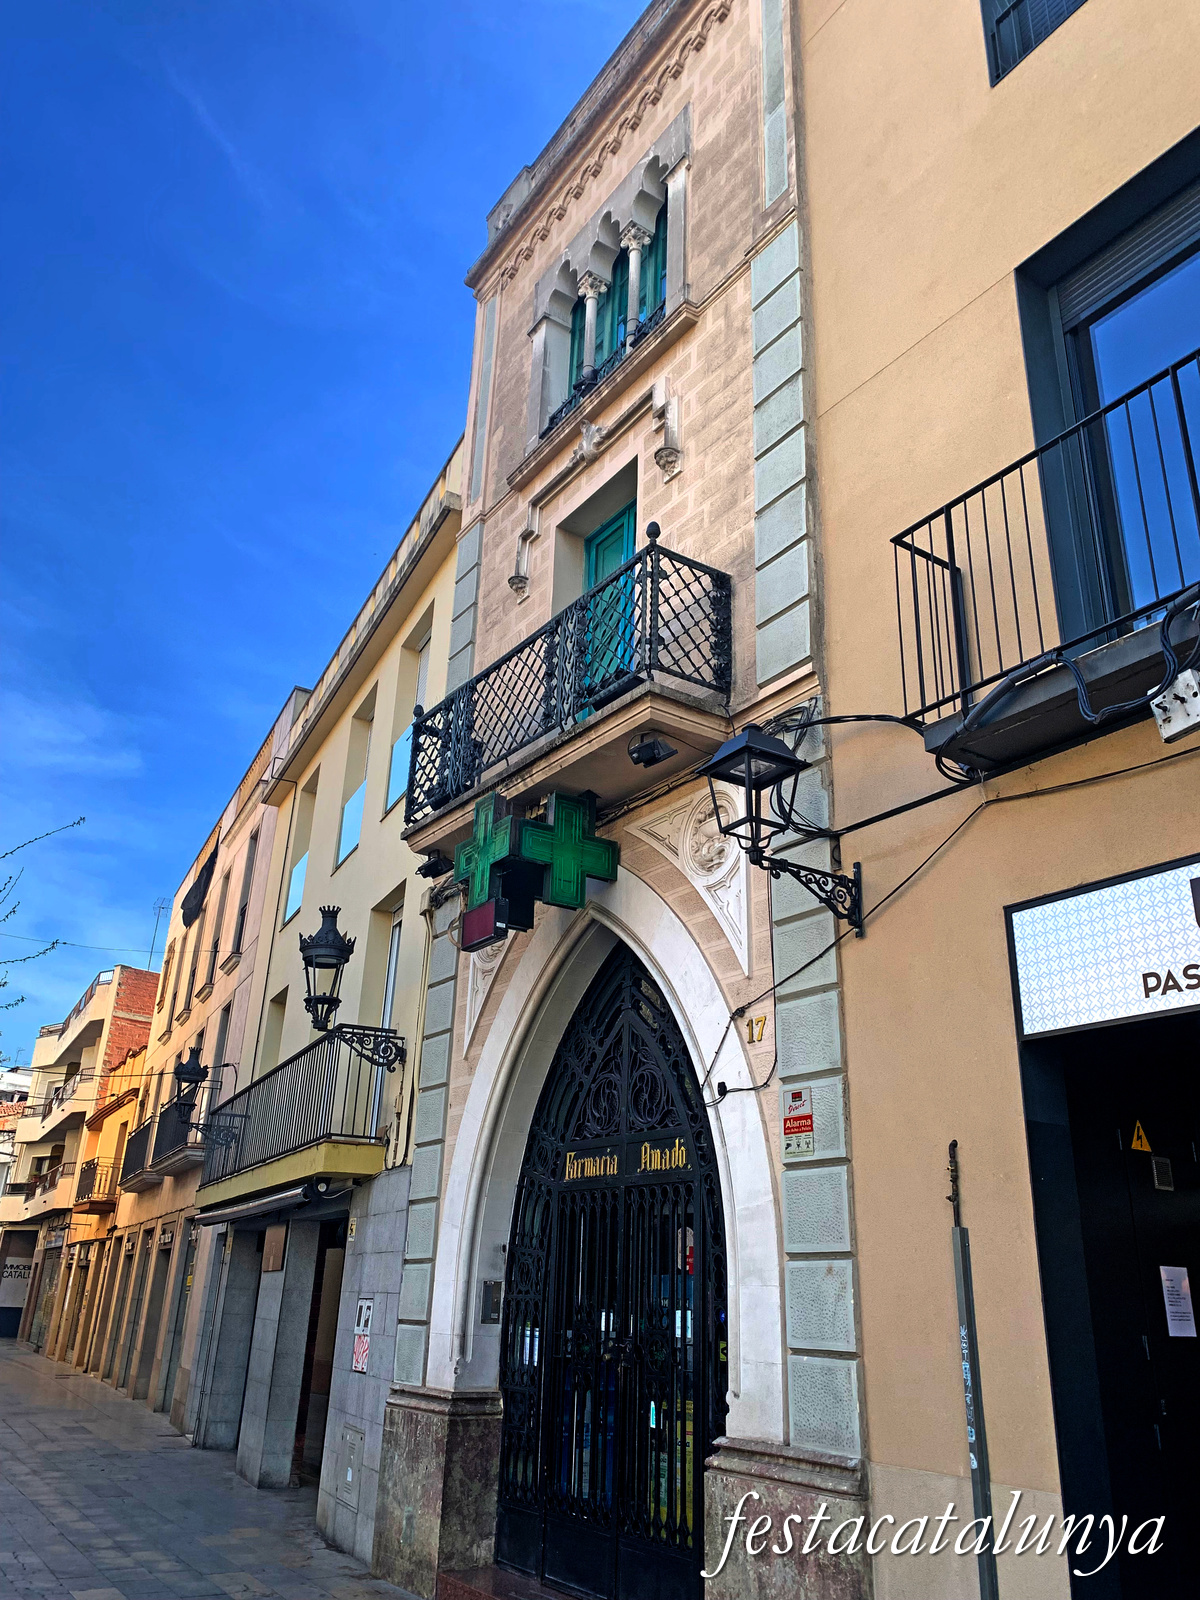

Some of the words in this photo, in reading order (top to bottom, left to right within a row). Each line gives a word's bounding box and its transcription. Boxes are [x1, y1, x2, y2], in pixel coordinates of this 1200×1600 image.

[1142, 964, 1200, 998] PAS
[745, 1016, 767, 1044] 17
[785, 1118, 811, 1129] Alarma
[564, 1148, 618, 1182] Farmacia
